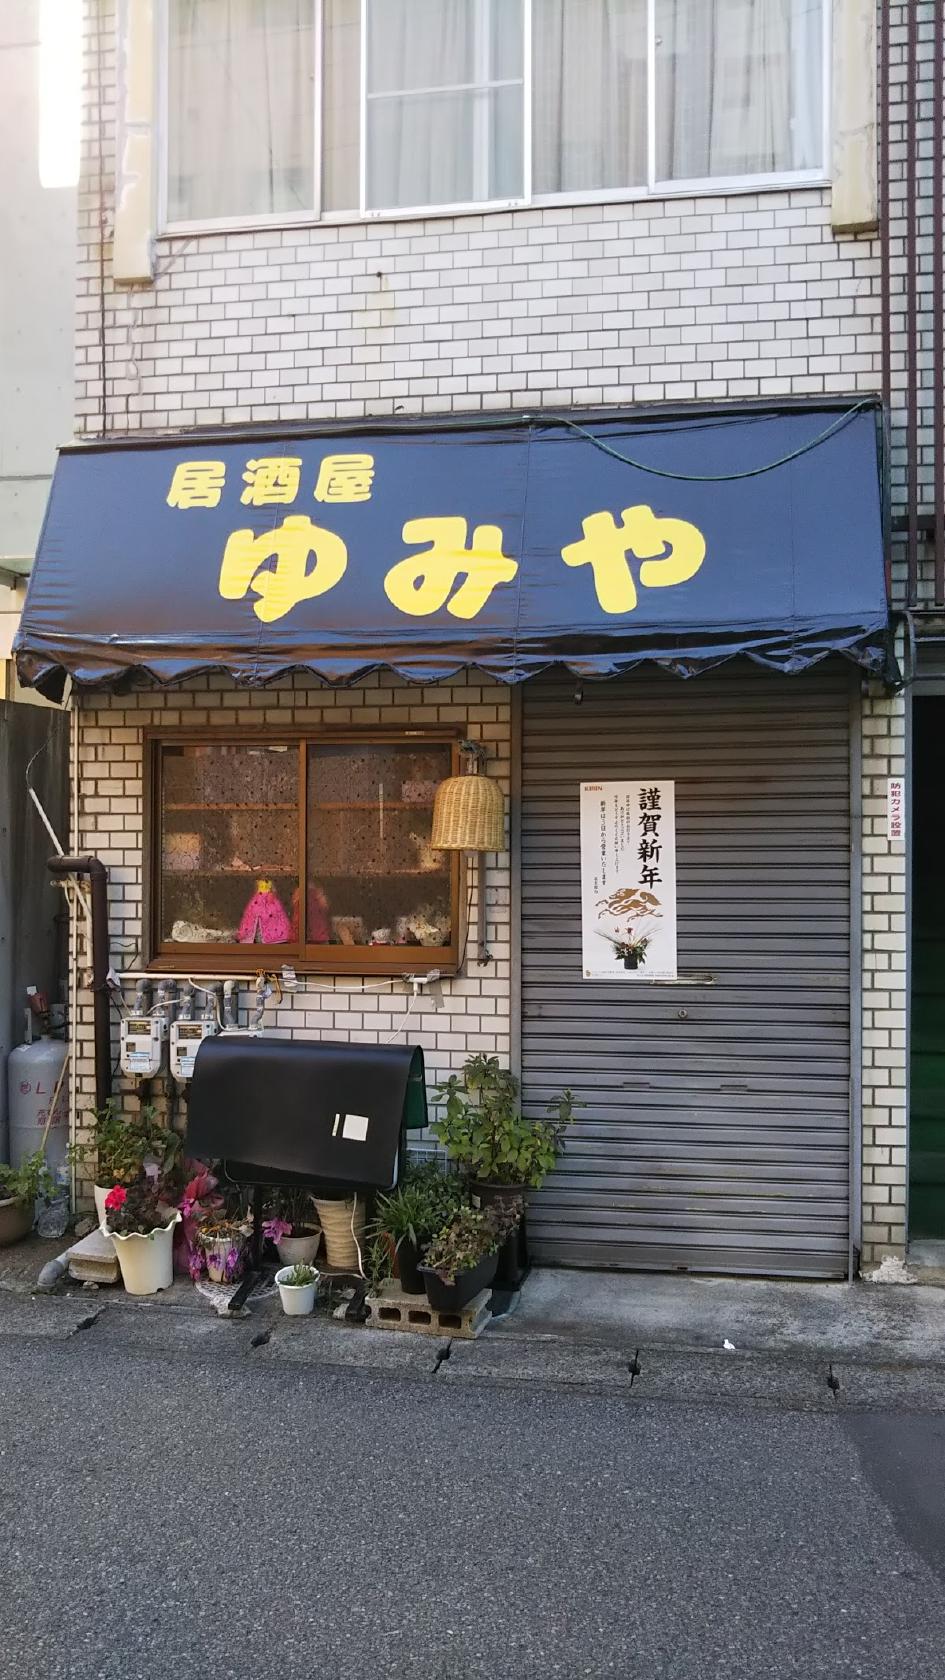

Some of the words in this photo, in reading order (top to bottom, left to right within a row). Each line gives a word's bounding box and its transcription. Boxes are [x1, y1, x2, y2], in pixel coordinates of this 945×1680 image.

[166, 453, 375, 509] 居酒屋
[218, 504, 707, 623] ゆみや
[637, 787, 663, 889] 謹賀新年
[890, 782, 902, 837] 防犯カメラ設置
